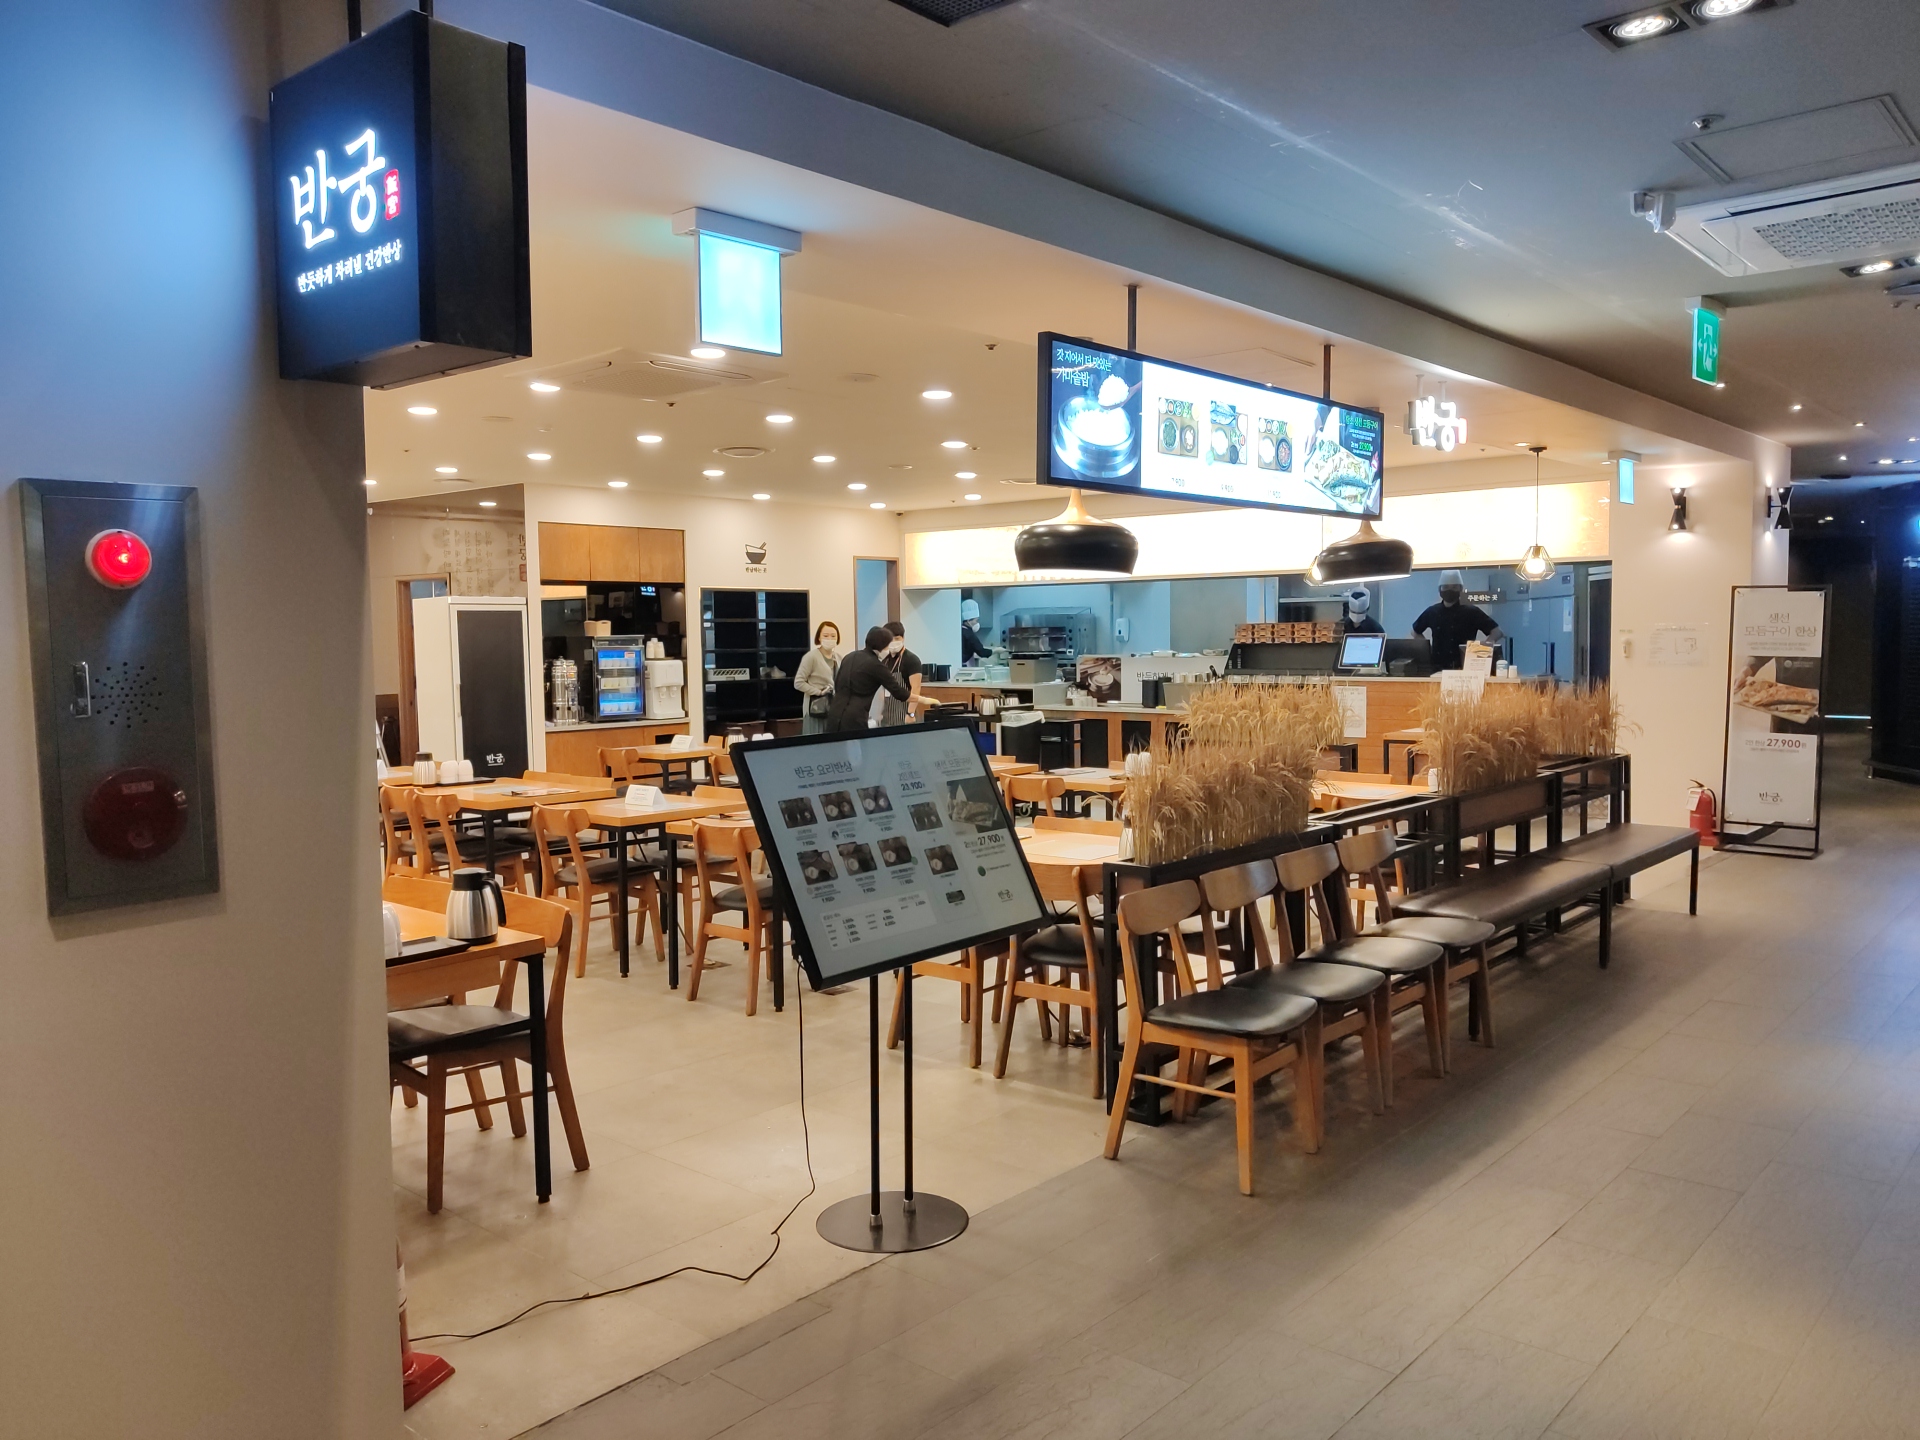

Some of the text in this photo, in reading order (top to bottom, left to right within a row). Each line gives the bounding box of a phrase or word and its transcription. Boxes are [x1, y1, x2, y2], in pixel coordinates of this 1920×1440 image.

[289, 128, 386, 250] 반궁
[297, 263, 333, 293] 반듯하게
[365, 238, 402, 271] 건강반상
[1056, 366, 1090, 388] 가마솥밥
[1413, 395, 1459, 452] 반궁
[1768, 612, 1790, 624] 생선
[1795, 625, 1818, 638] 한상
[486, 752, 504, 764] 반궁
[794, 759, 853, 779] 반궁 요리반상
[1758, 790, 1781, 803] 반궁
